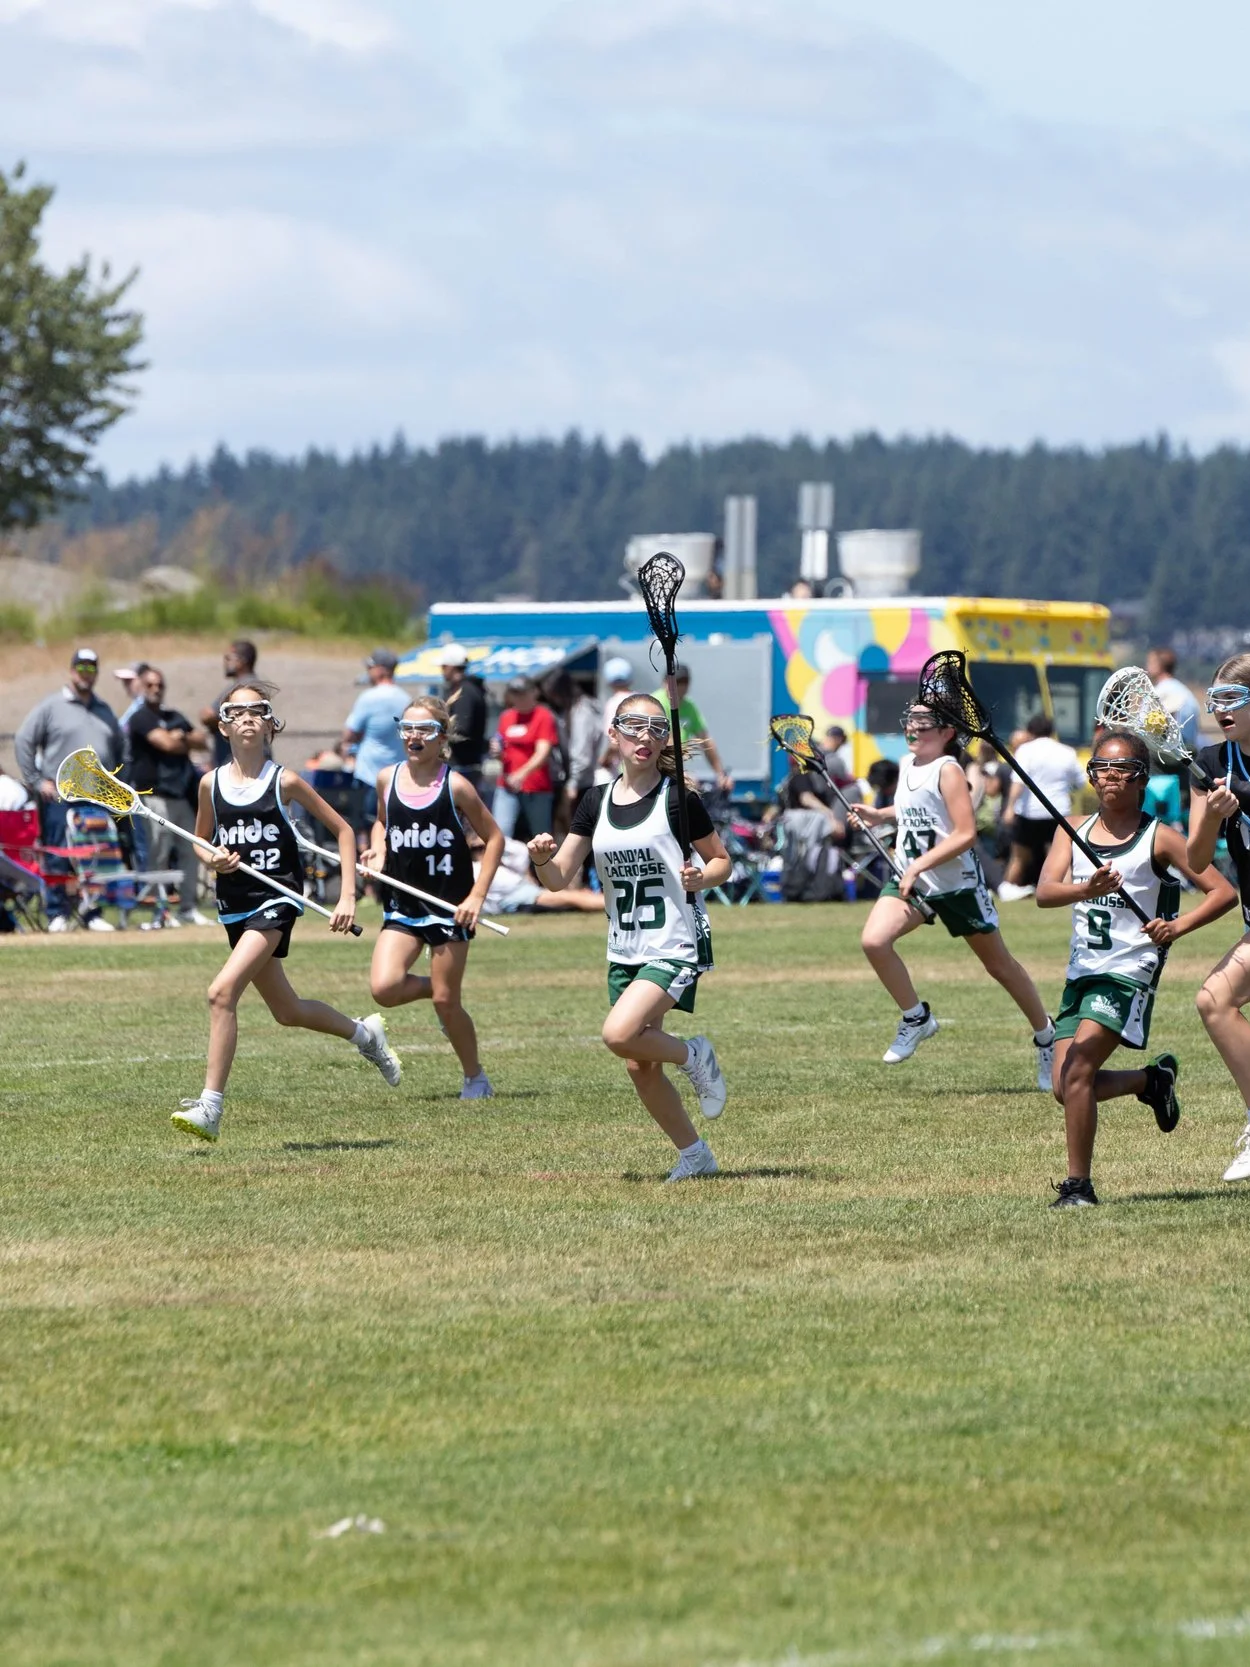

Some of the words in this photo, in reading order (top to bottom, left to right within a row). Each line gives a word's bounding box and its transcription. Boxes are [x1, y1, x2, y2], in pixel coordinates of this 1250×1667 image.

[219, 817, 281, 847] pride
[390, 822, 455, 853] pride
[902, 829, 937, 858] 47
[250, 848, 281, 870] 32
[425, 853, 454, 876] 14
[604, 862, 667, 878] LACROSSE
[611, 878, 666, 931] 25
[1087, 908, 1113, 950] 9
